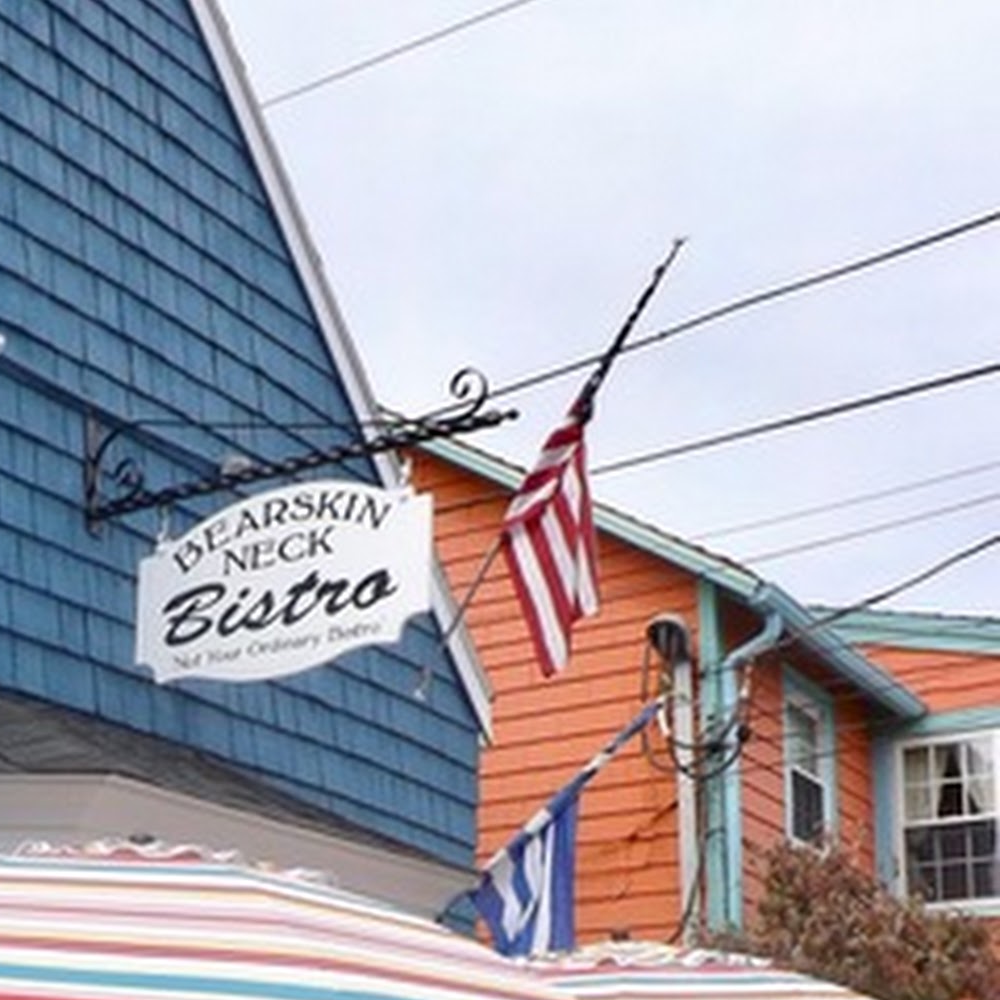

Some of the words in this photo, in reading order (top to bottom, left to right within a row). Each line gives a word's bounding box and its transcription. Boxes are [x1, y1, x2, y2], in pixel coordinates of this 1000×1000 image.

[173, 490, 391, 574] BEARSKIN
[223, 525, 335, 576] NECK
[162, 568, 399, 647] Bistro
[246, 633, 320, 659] Ordinary
